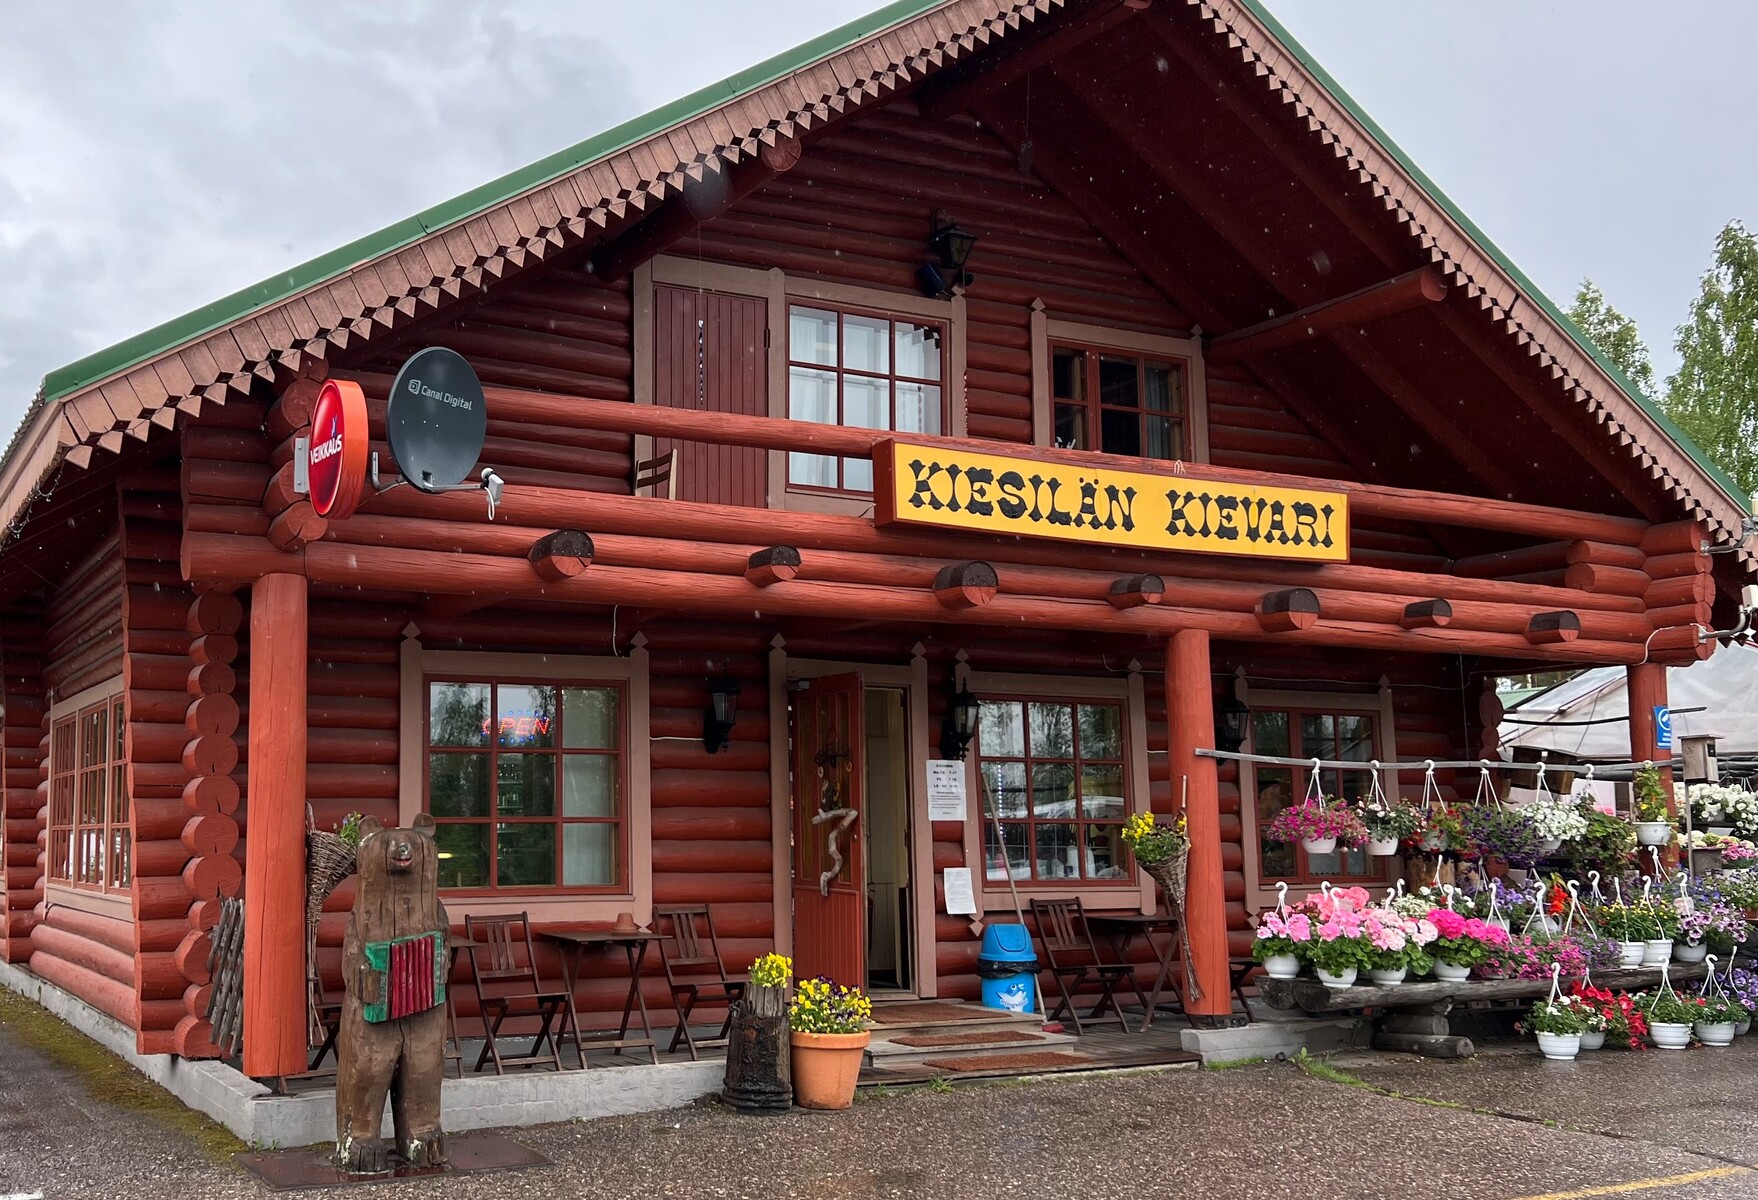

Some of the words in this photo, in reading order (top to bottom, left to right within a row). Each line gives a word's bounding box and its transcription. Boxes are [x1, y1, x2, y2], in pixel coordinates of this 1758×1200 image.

[421, 385, 443, 401] Canal
[443, 393, 473, 410] Digital
[310, 434, 342, 466] VEIKKAUS
[908, 459, 1137, 532] KIESILÄN
[1165, 489, 1335, 548] KIEVARI
